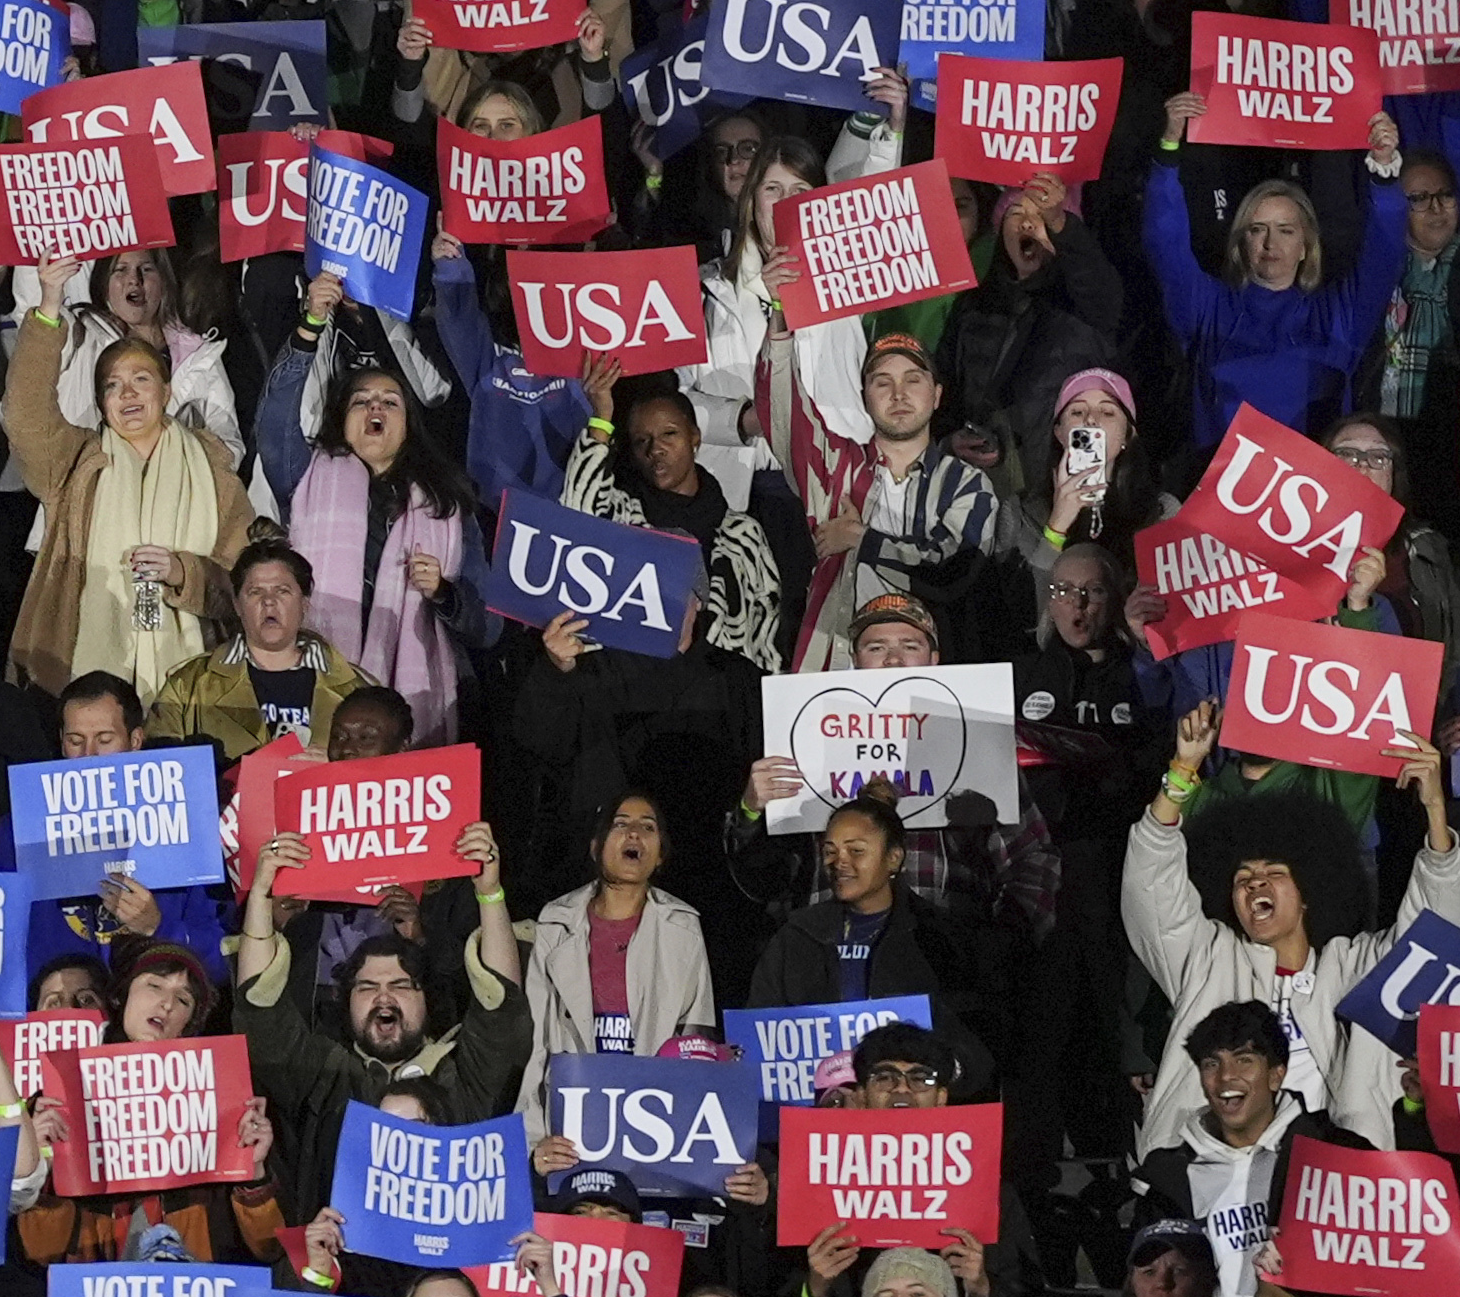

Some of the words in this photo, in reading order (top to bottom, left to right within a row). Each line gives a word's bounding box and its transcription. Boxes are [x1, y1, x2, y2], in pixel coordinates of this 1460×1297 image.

[962, 80, 1099, 132] HARRIS
[982, 132, 1077, 164] WALZ
[800, 178, 919, 239] FREEDOM
[804, 215, 928, 275] FREEDOM
[813, 251, 939, 311] FREEDOM
[509, 521, 672, 631] USA
[820, 712, 928, 739] GRITTY
[856, 742, 901, 762] FOR
[301, 775, 451, 834] HARRIS
[323, 826, 427, 862] WALZ
[571, 1172, 617, 1189] HARRIS
[810, 1132, 971, 1185] HARRIS
[833, 1190, 947, 1219] WALZ
[1297, 1167, 1450, 1235] HARRIS
[1313, 1230, 1425, 1269] WALZ
